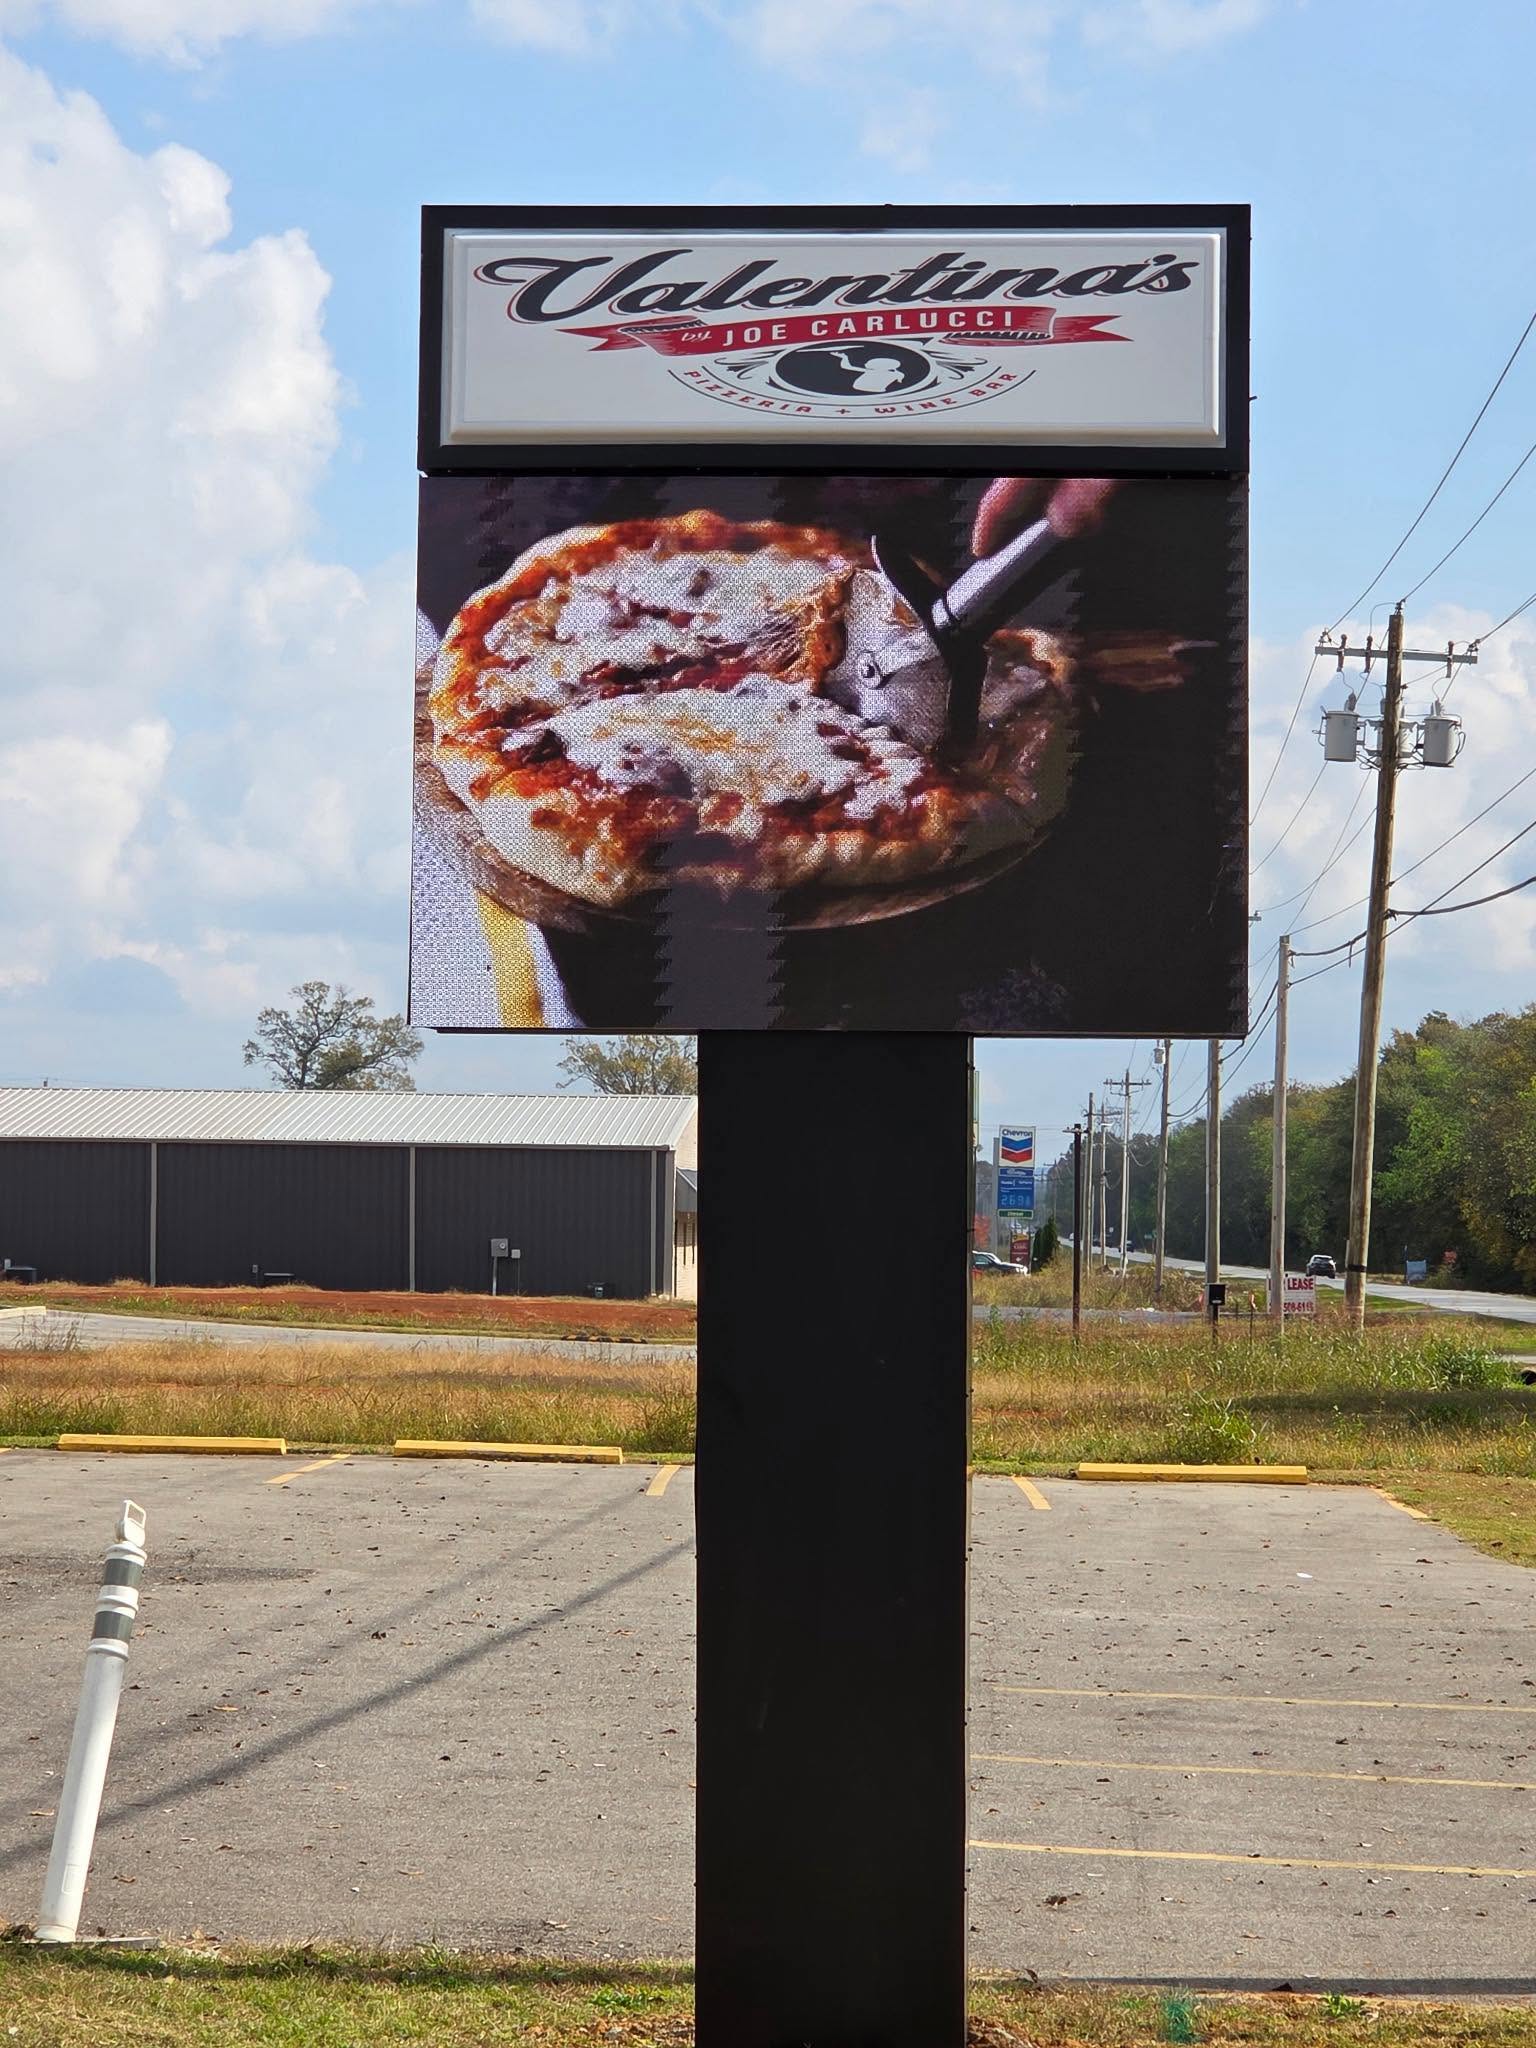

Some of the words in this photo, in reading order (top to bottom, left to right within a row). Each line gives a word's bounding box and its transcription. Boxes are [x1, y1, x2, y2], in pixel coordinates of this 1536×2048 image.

[474, 249, 1200, 324] Valentina's
[681, 328, 712, 343] by
[722, 324, 787, 347] JOE
[811, 311, 1013, 337] CARLUCCI
[683, 370, 812, 414] PIZZERIA
[874, 397, 957, 415] WINE
[968, 373, 1018, 398] BAR
[1001, 1129, 1033, 1137] Chevron
[1287, 1278, 1314, 1290] LEASE
